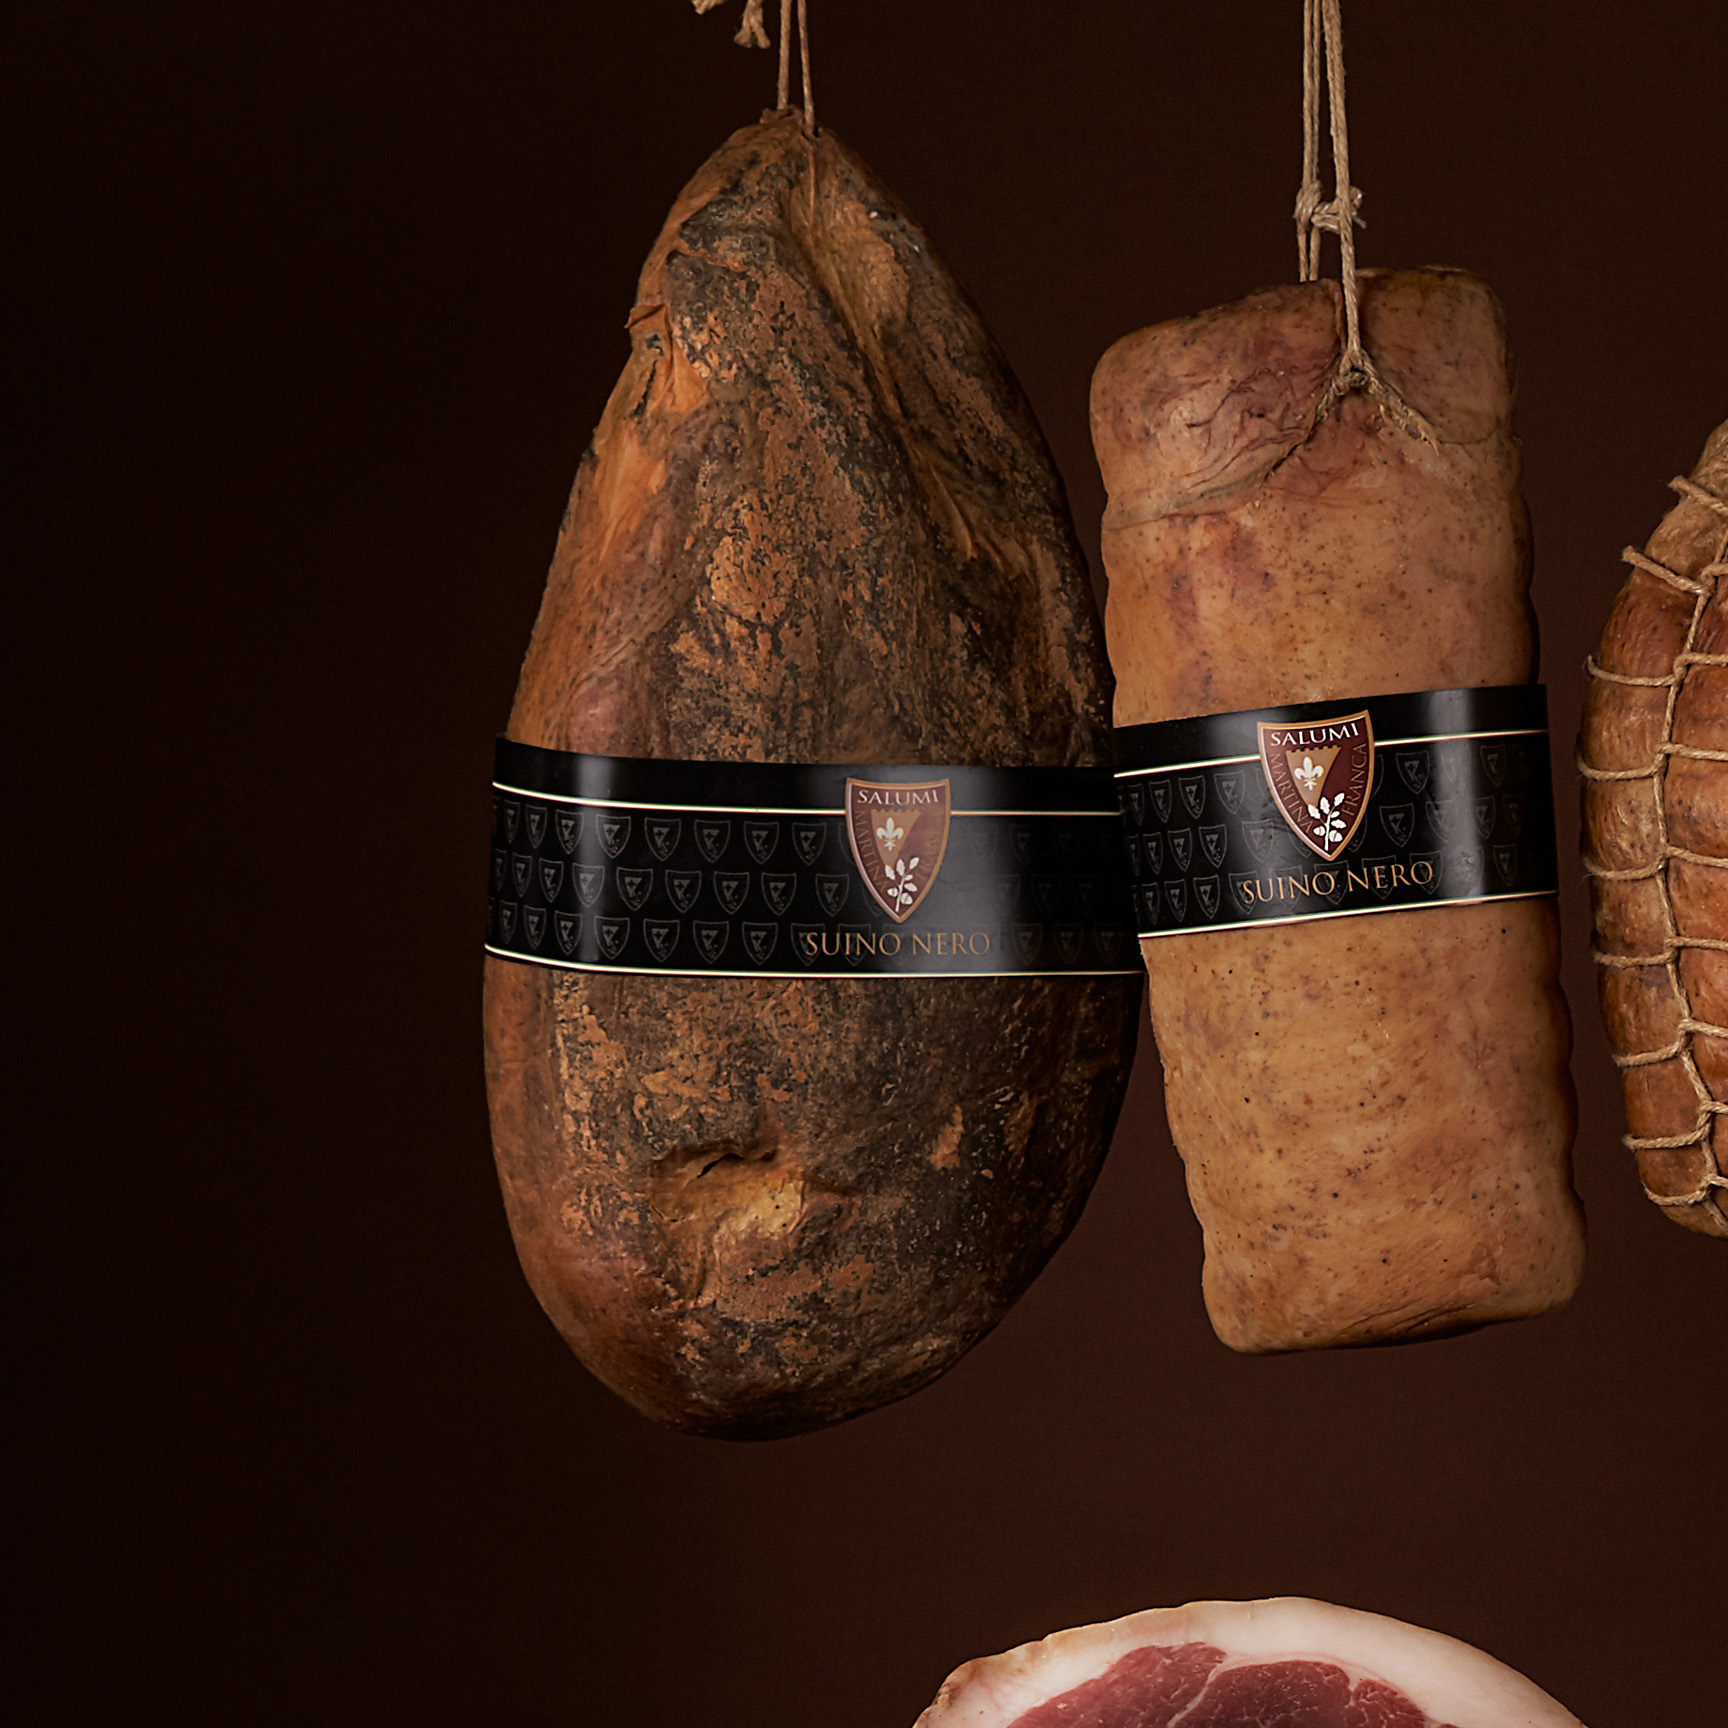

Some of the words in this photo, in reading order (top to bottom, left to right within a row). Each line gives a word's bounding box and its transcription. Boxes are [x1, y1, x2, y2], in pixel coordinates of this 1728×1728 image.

[1270, 722, 1360, 746] SALUMI
[857, 789, 940, 805] SALUMI
[1269, 753, 1315, 834] MARTINA
[1341, 743, 1367, 816] FRANCA
[854, 810, 889, 892] MARTINA
[1243, 871, 1336, 905] SUINO
[1346, 860, 1434, 894] NERO
[804, 932, 901, 956] SUINO
[912, 932, 990, 956] NERO
